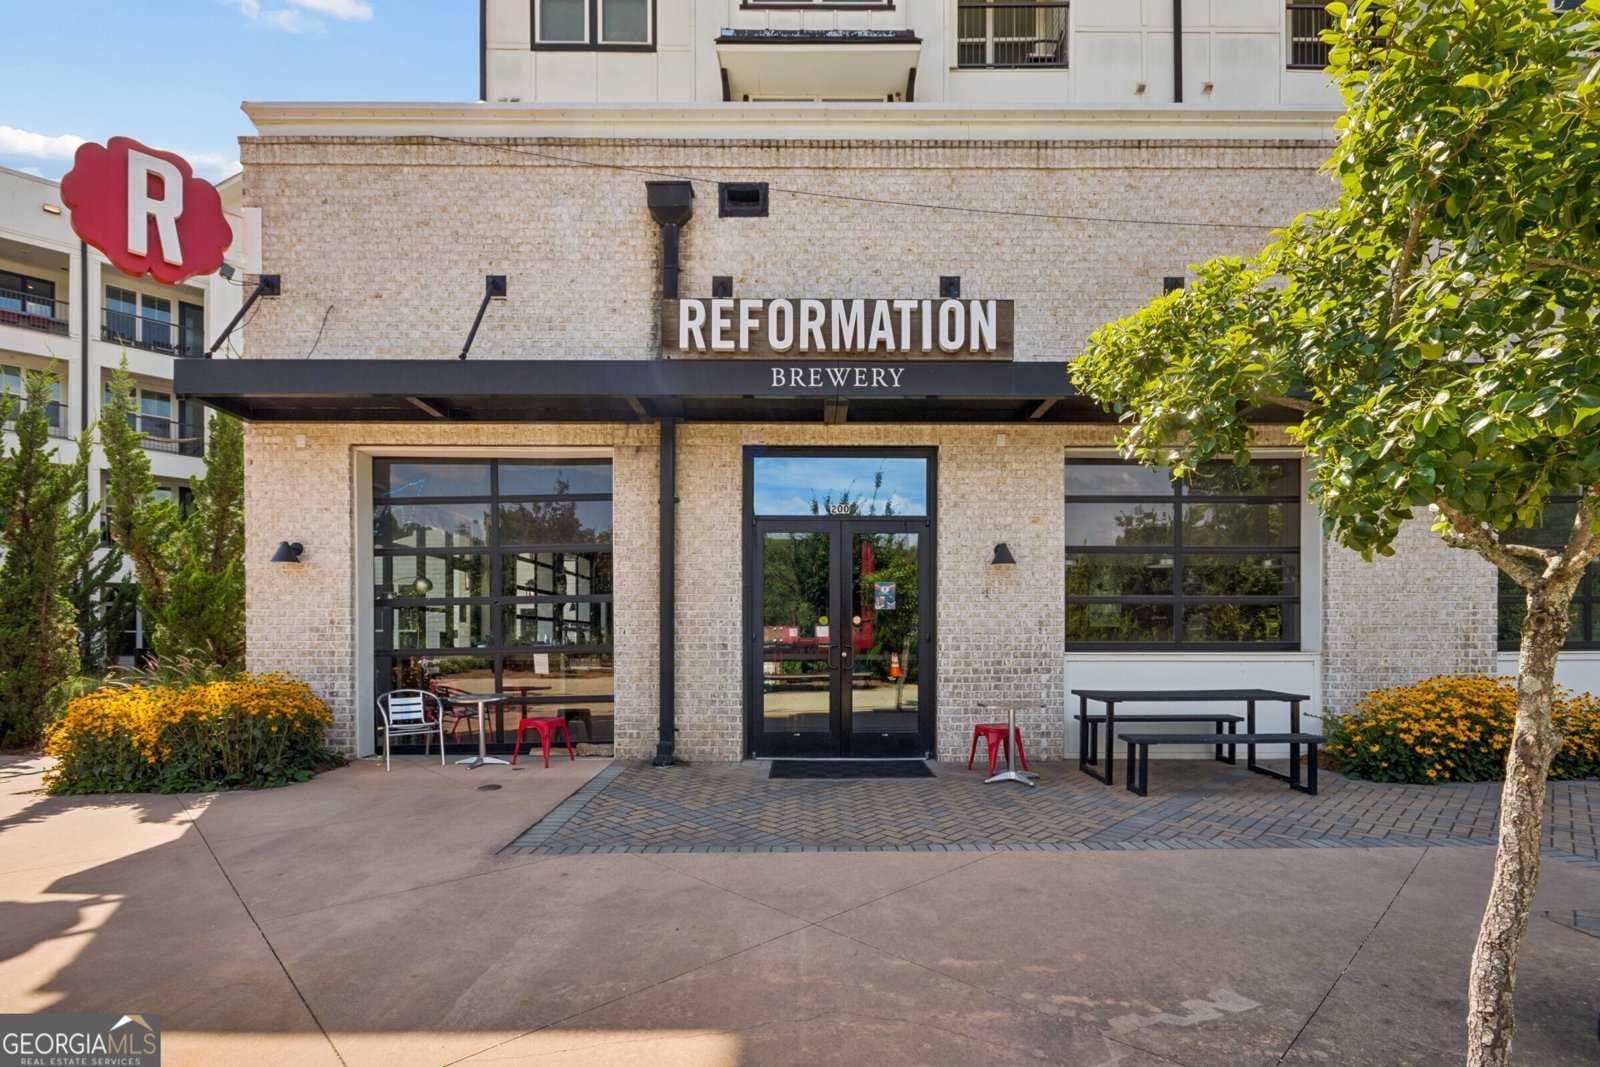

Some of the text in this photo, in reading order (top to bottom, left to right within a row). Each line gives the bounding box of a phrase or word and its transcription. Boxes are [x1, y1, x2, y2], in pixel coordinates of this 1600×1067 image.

[127, 148, 183, 266] R
[678, 298, 998, 353] REFORMATION
[770, 367, 905, 388] BREWERY
[831, 504, 849, 513] 200
